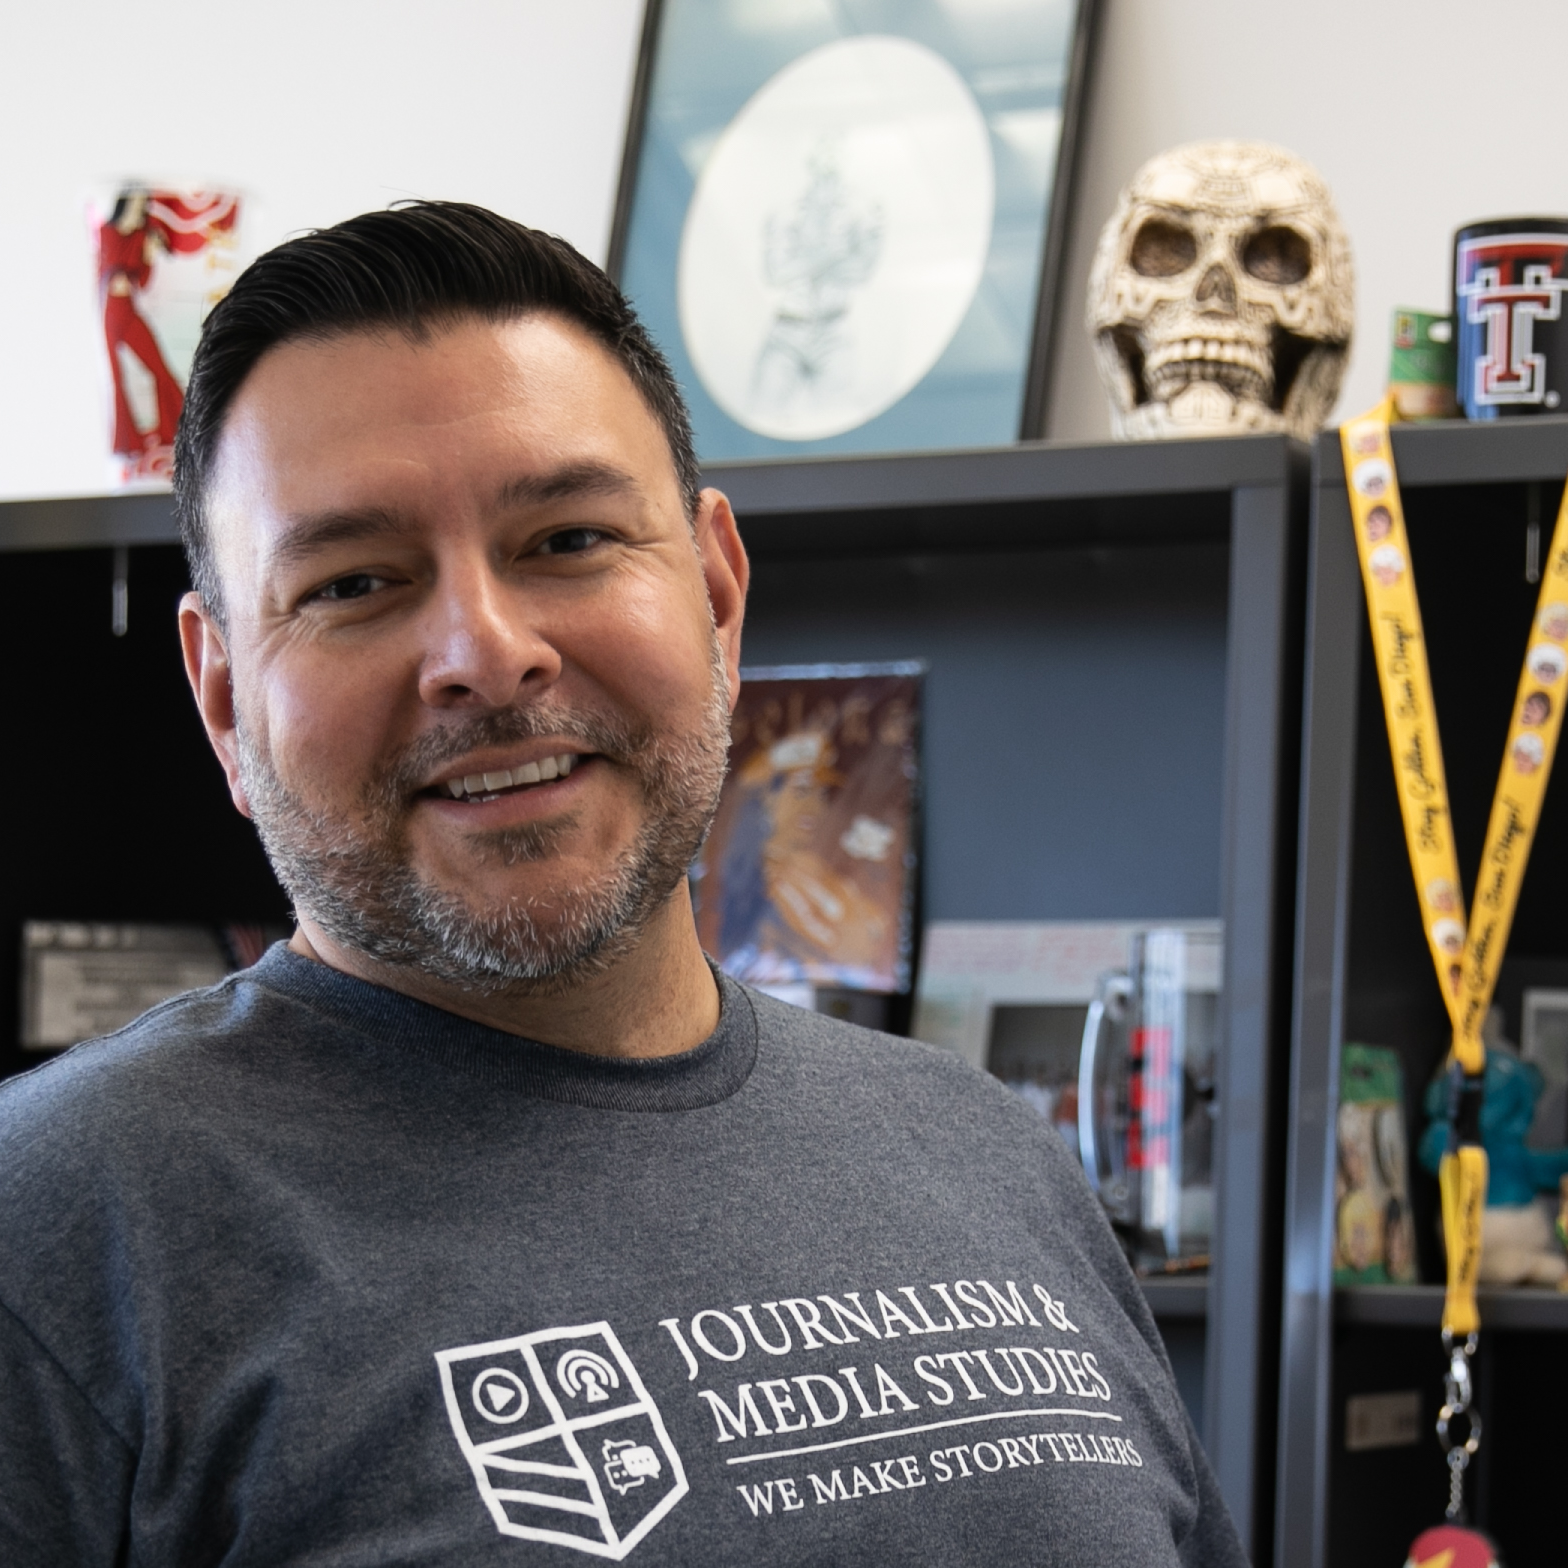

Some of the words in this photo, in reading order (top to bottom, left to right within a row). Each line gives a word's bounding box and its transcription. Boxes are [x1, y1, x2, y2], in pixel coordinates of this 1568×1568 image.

[658, 1280, 1040, 1381] JOURNALISM
[1035, 1284, 1079, 1335] &
[698, 1365, 920, 1444] MEDIA
[913, 1348, 1113, 1408] STUDIES
[736, 1476, 807, 1518] WE
[807, 1458, 928, 1505] MAKE
[928, 1437, 1143, 1486] STORYTELLERS
